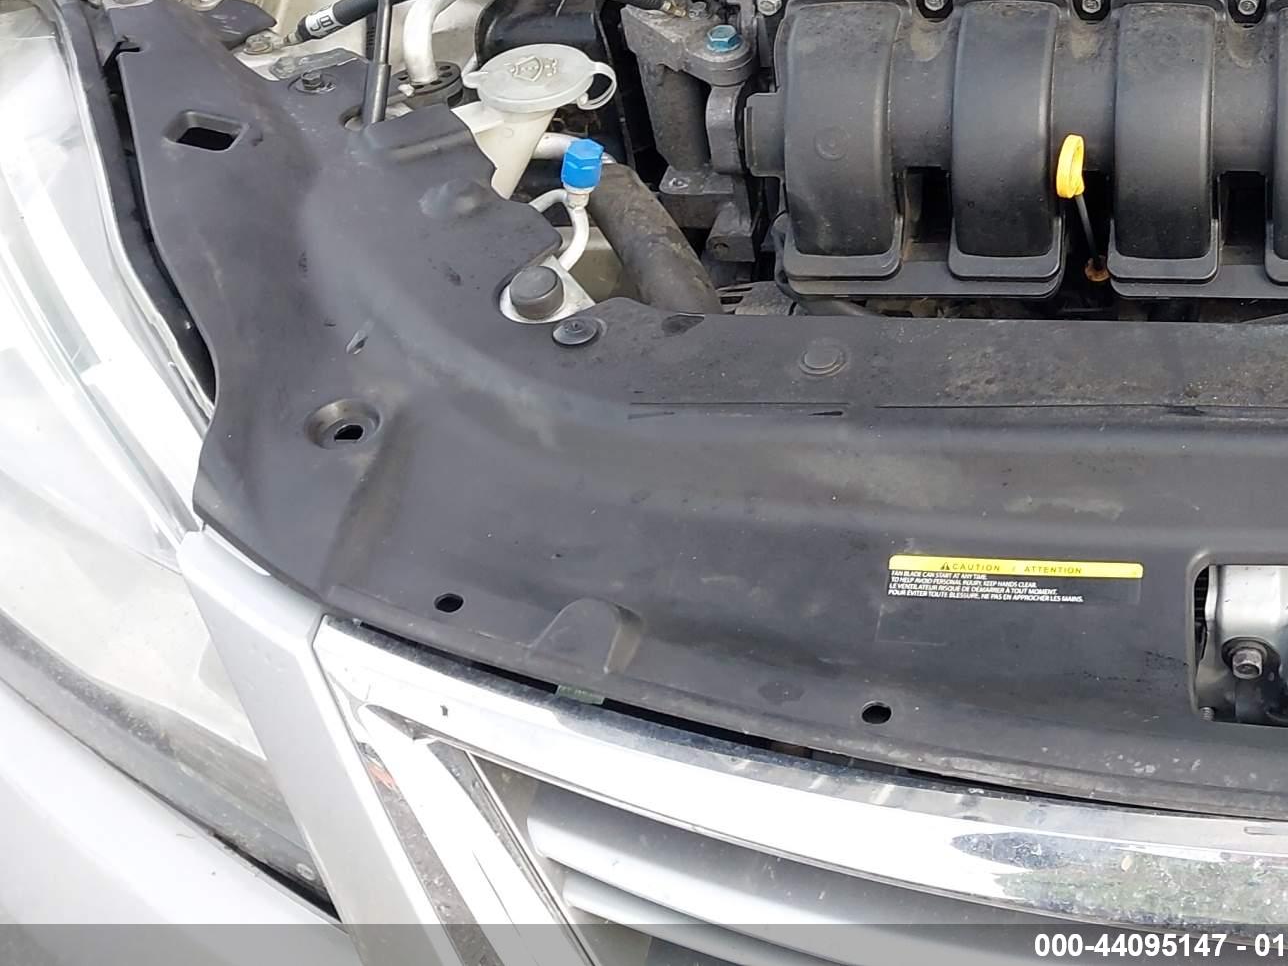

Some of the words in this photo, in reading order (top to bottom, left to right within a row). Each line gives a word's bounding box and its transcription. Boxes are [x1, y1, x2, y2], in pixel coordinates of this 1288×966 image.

[952, 563, 1001, 571] CAUTION
[1024, 566, 1082, 574] ATTENTION
[897, 583, 938, 591] VENTILATEUR
[1012, 594, 1049, 602] APPROCHER
